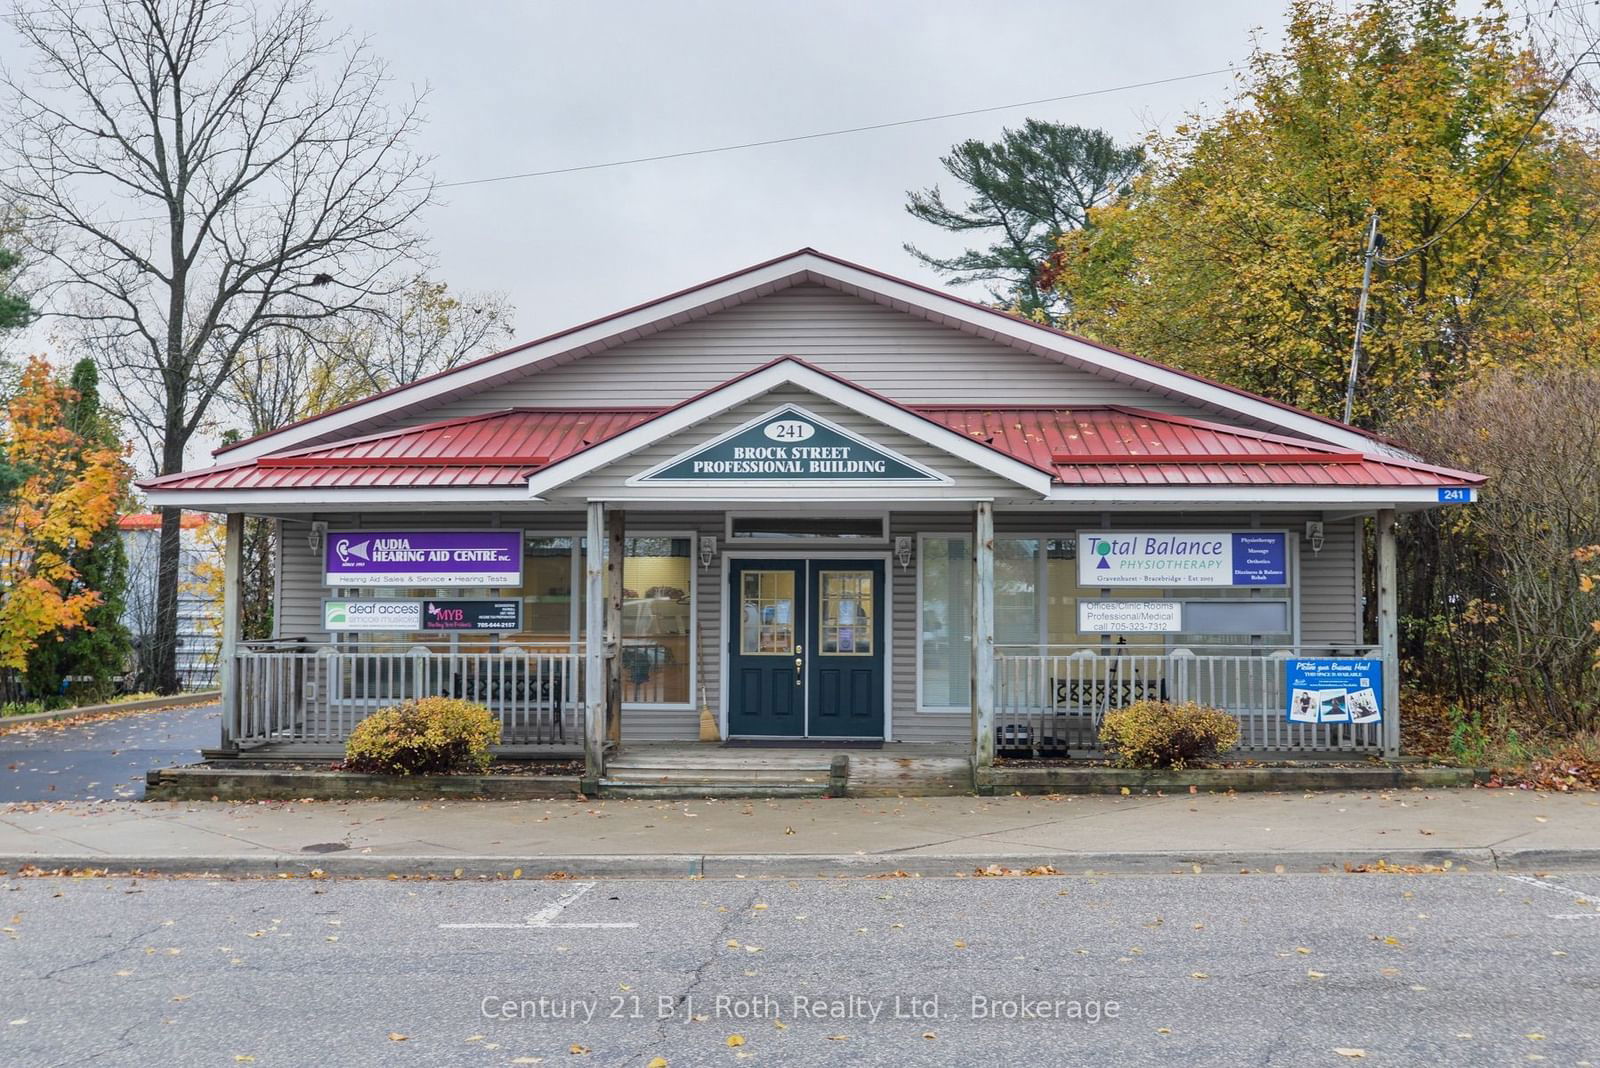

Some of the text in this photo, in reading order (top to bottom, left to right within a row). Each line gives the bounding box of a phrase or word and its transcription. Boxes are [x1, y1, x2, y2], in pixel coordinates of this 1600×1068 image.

[776, 425, 804, 438] 241
[734, 447, 850, 460] BROCK STREET
[693, 461, 886, 473] PROFESSIONAL BUILDING
[1444, 490, 1463, 500] 241
[374, 538, 410, 550] AUDIA
[1088, 537, 1223, 556] Total Balance
[372, 550, 425, 562] HEARING
[428, 550, 450, 562] AID
[454, 550, 498, 562] CENTRE
[1120, 560, 1223, 570] PHYSIOTHERAPY
[1144, 575, 1182, 583] Bracebridge
[349, 603, 419, 614] deaf access
[1144, 602, 1174, 610] Rooms
[437, 608, 463, 620] MYB
[1087, 612, 1174, 620] Professional/Medical
[1094, 622, 1167, 631] call 705-323-7312
